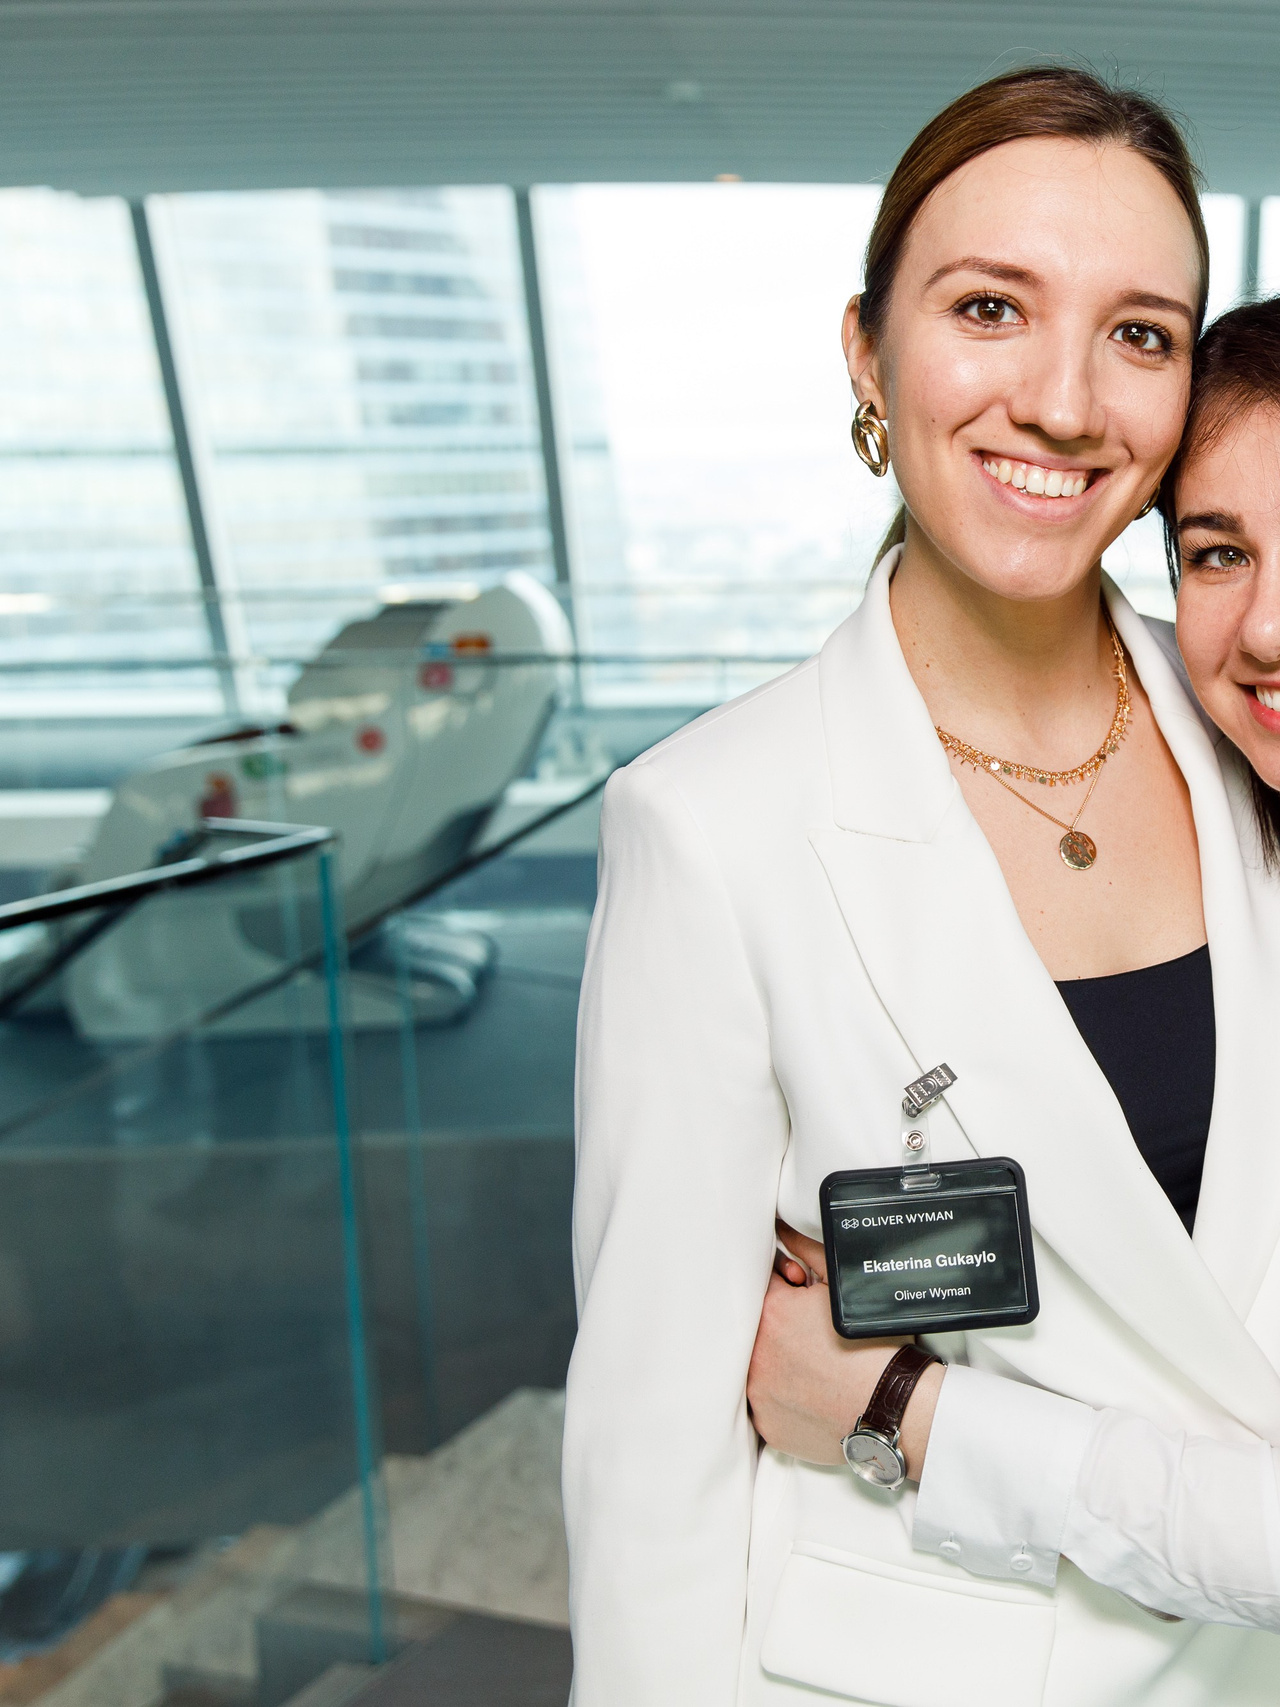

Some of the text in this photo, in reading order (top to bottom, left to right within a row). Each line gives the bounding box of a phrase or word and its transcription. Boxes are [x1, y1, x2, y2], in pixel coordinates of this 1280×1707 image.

[861, 1210, 954, 1228] OLIVER WYMAN
[863, 1250, 997, 1274] Ekaterina Gukaylo
[894, 1286, 971, 1301] Oliver Wyman
